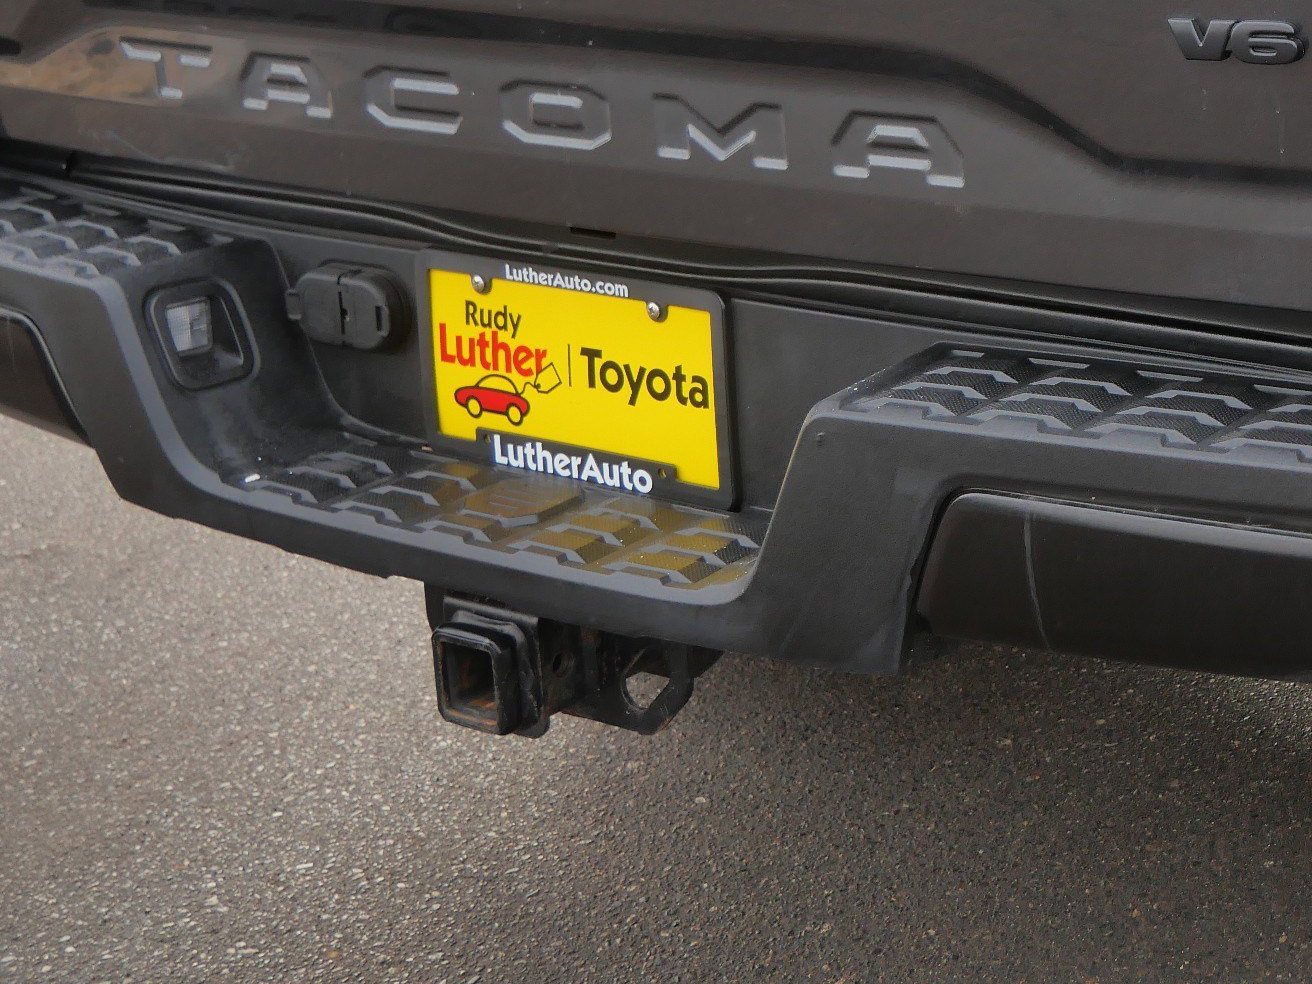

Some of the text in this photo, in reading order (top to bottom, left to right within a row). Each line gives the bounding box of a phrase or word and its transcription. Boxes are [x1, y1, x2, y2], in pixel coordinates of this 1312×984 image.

[1167, 17, 1306, 66] V6
[117, 34, 966, 189] TACOMA
[503, 263, 630, 298] LutherAuto.com
[464, 299, 523, 339] Rudy
[438, 322, 548, 377] Luther
[579, 346, 710, 409] Toyota
[492, 433, 653, 494] LutherAuto
